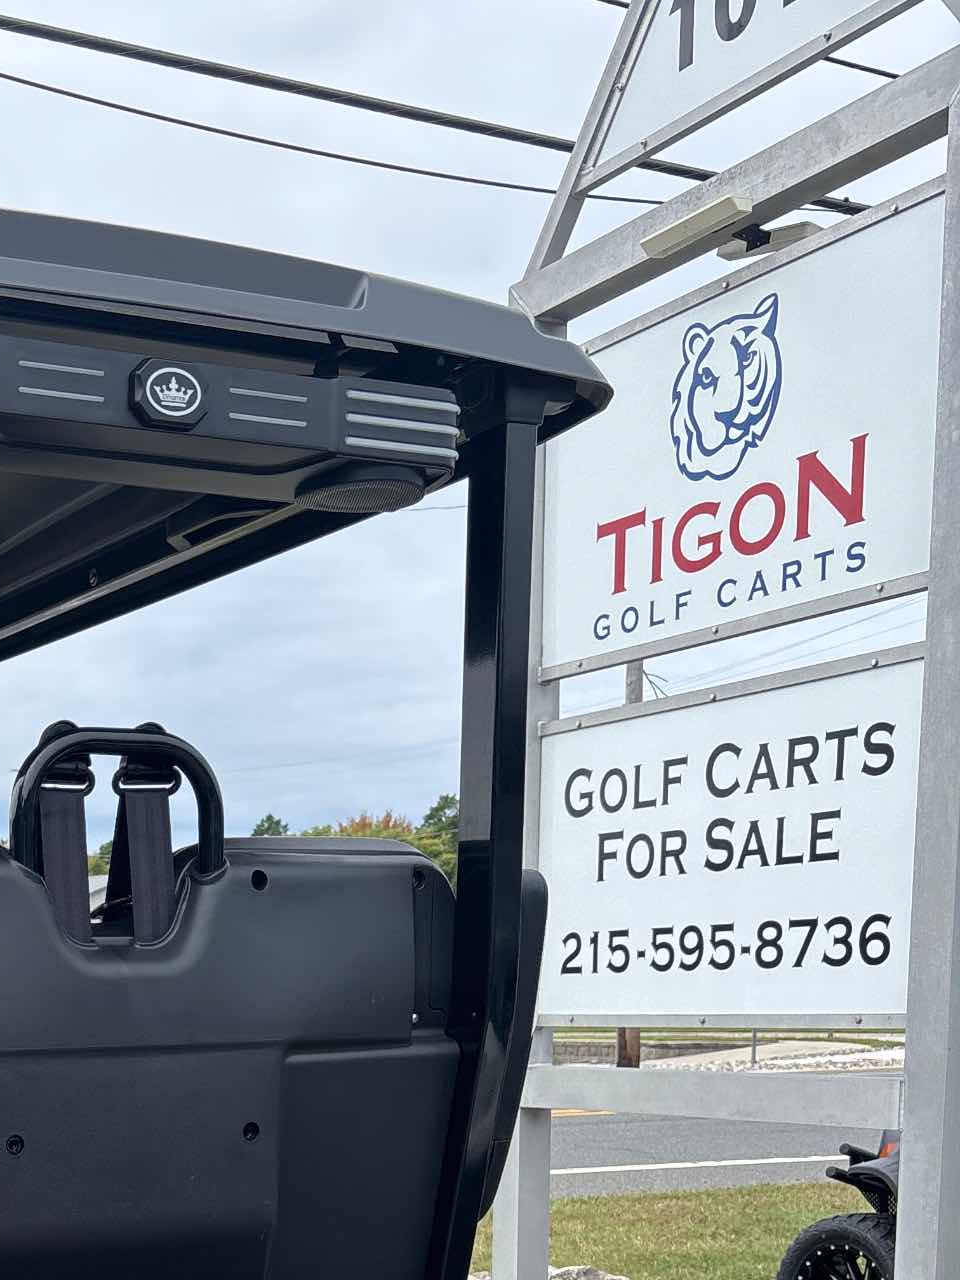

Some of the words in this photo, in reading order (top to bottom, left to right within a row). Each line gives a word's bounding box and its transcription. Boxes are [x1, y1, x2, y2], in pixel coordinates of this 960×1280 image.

[596, 433, 870, 595] TIGON
[593, 591, 691, 641] GOLF
[716, 541, 868, 609] CARTS
[564, 753, 689, 818] GOLF
[705, 721, 897, 799] CARTS
[596, 828, 688, 882] FOR
[703, 807, 842, 872] SALE
[559, 912, 894, 976] 215-595-8736
